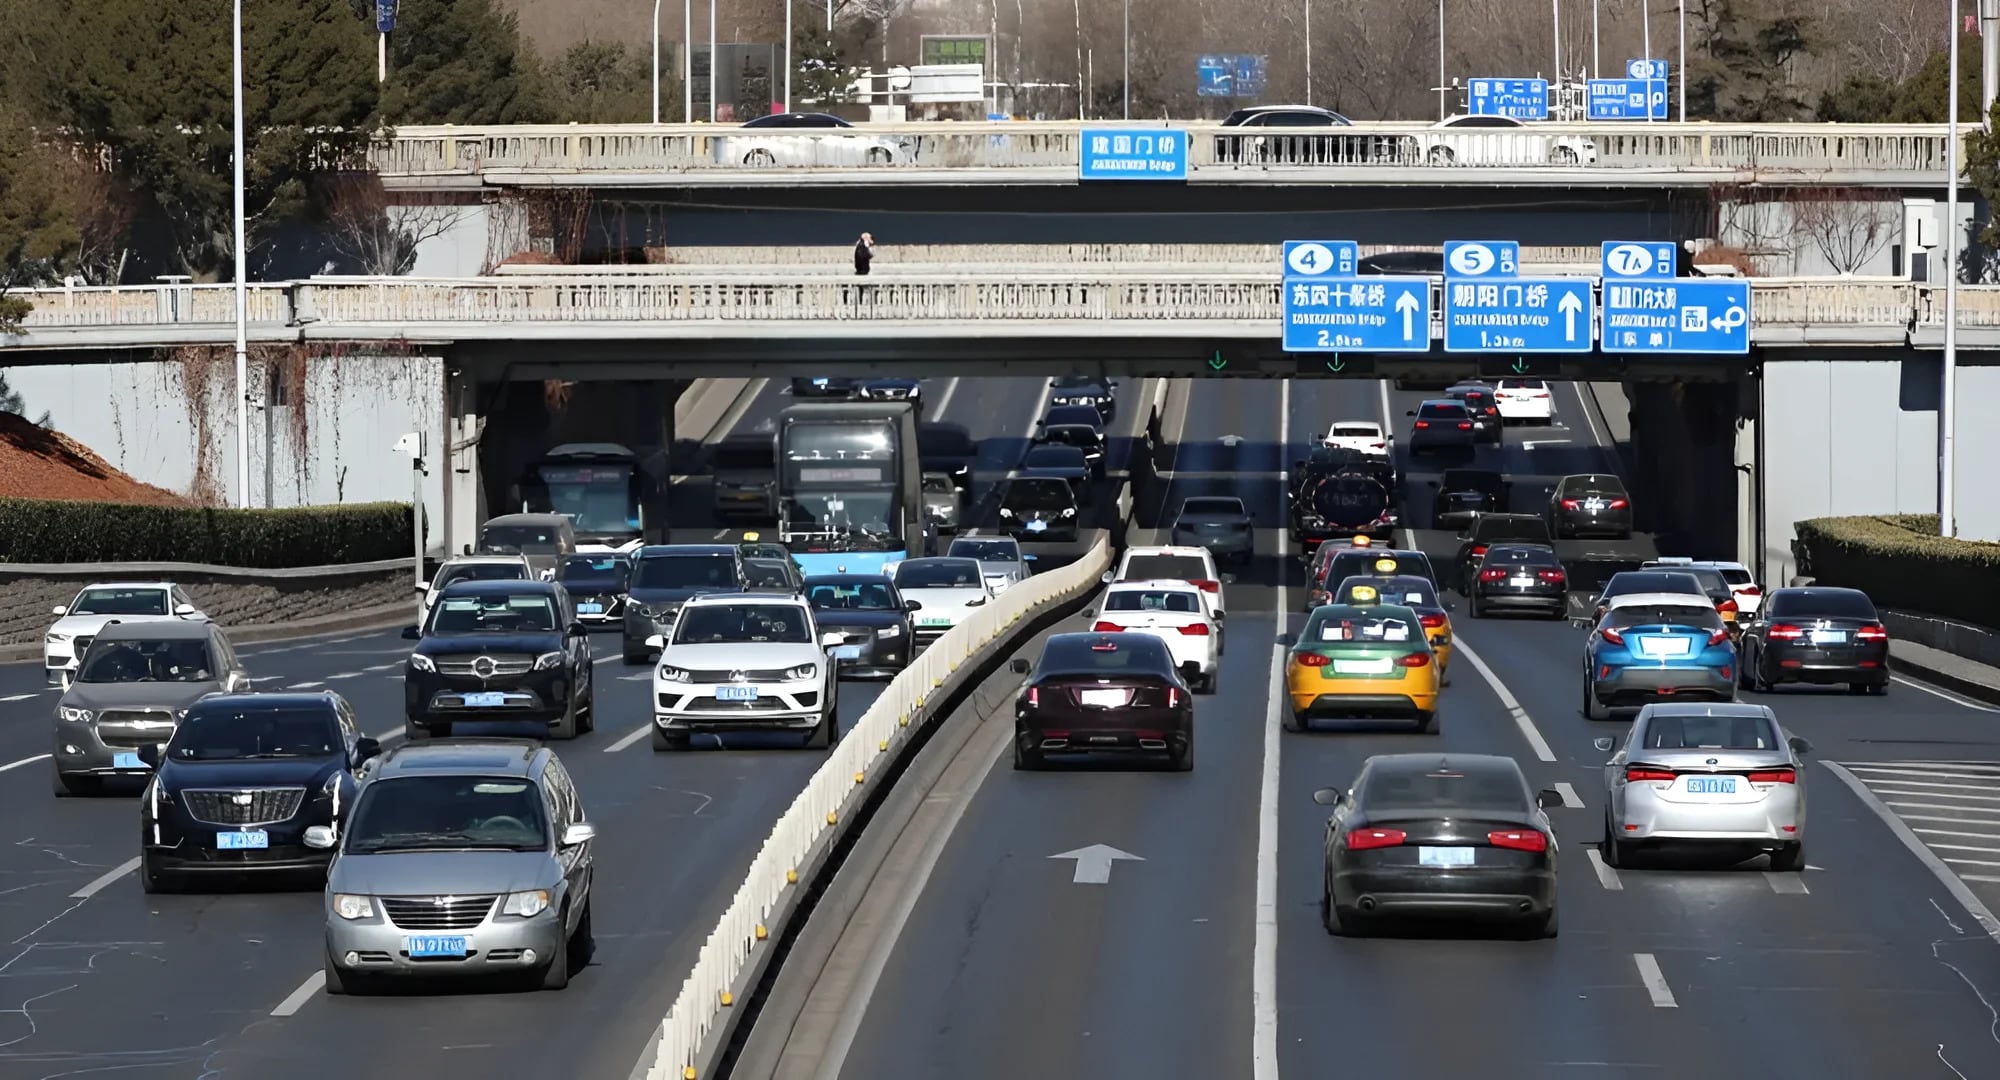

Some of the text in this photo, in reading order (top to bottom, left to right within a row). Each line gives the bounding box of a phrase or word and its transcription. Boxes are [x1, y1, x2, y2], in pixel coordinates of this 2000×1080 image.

[1300, 249, 1317, 269] 4
[1464, 250, 1480, 270] 5
[1454, 284, 1548, 308] 朝阳门桥
